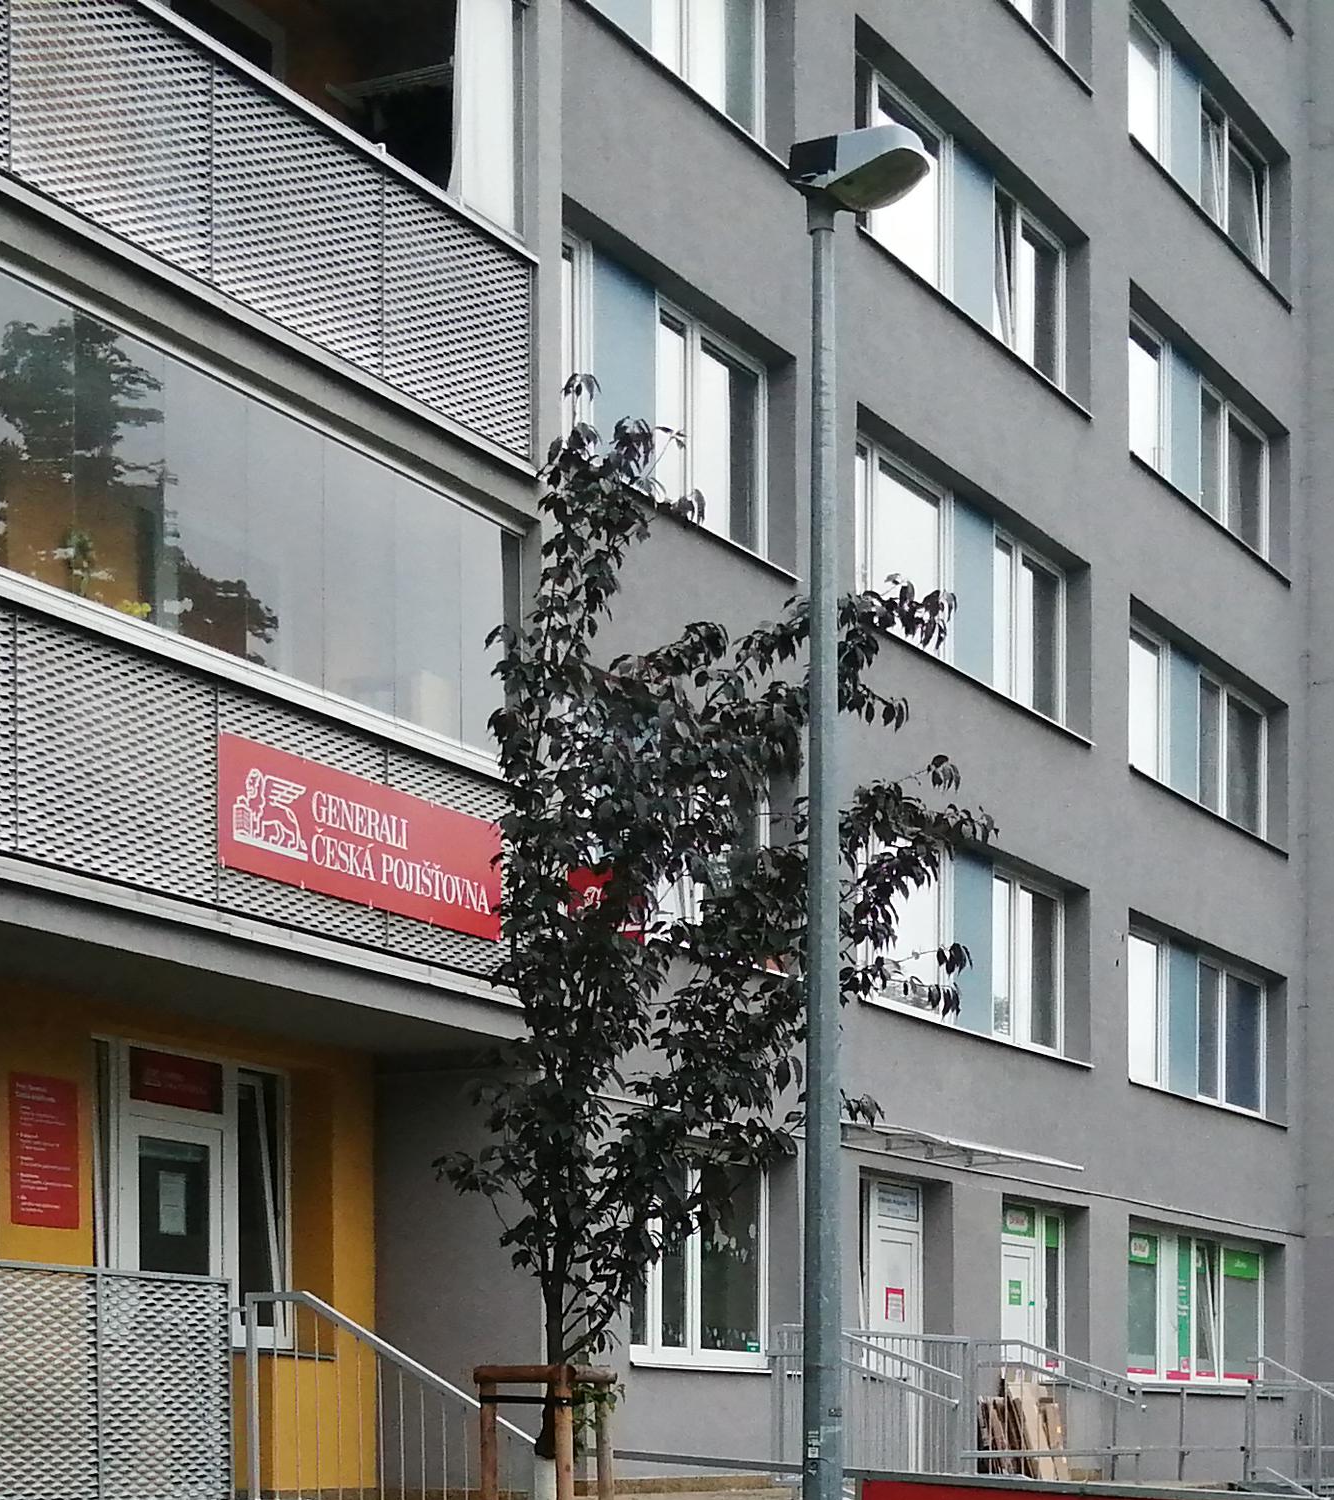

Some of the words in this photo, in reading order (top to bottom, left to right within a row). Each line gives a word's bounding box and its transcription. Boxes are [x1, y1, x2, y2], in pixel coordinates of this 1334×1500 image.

[311, 790, 408, 851] GENERALI
[311, 827, 376, 884] ČESKÁ
[381, 852, 492, 916] POJIŠŤOVNA
